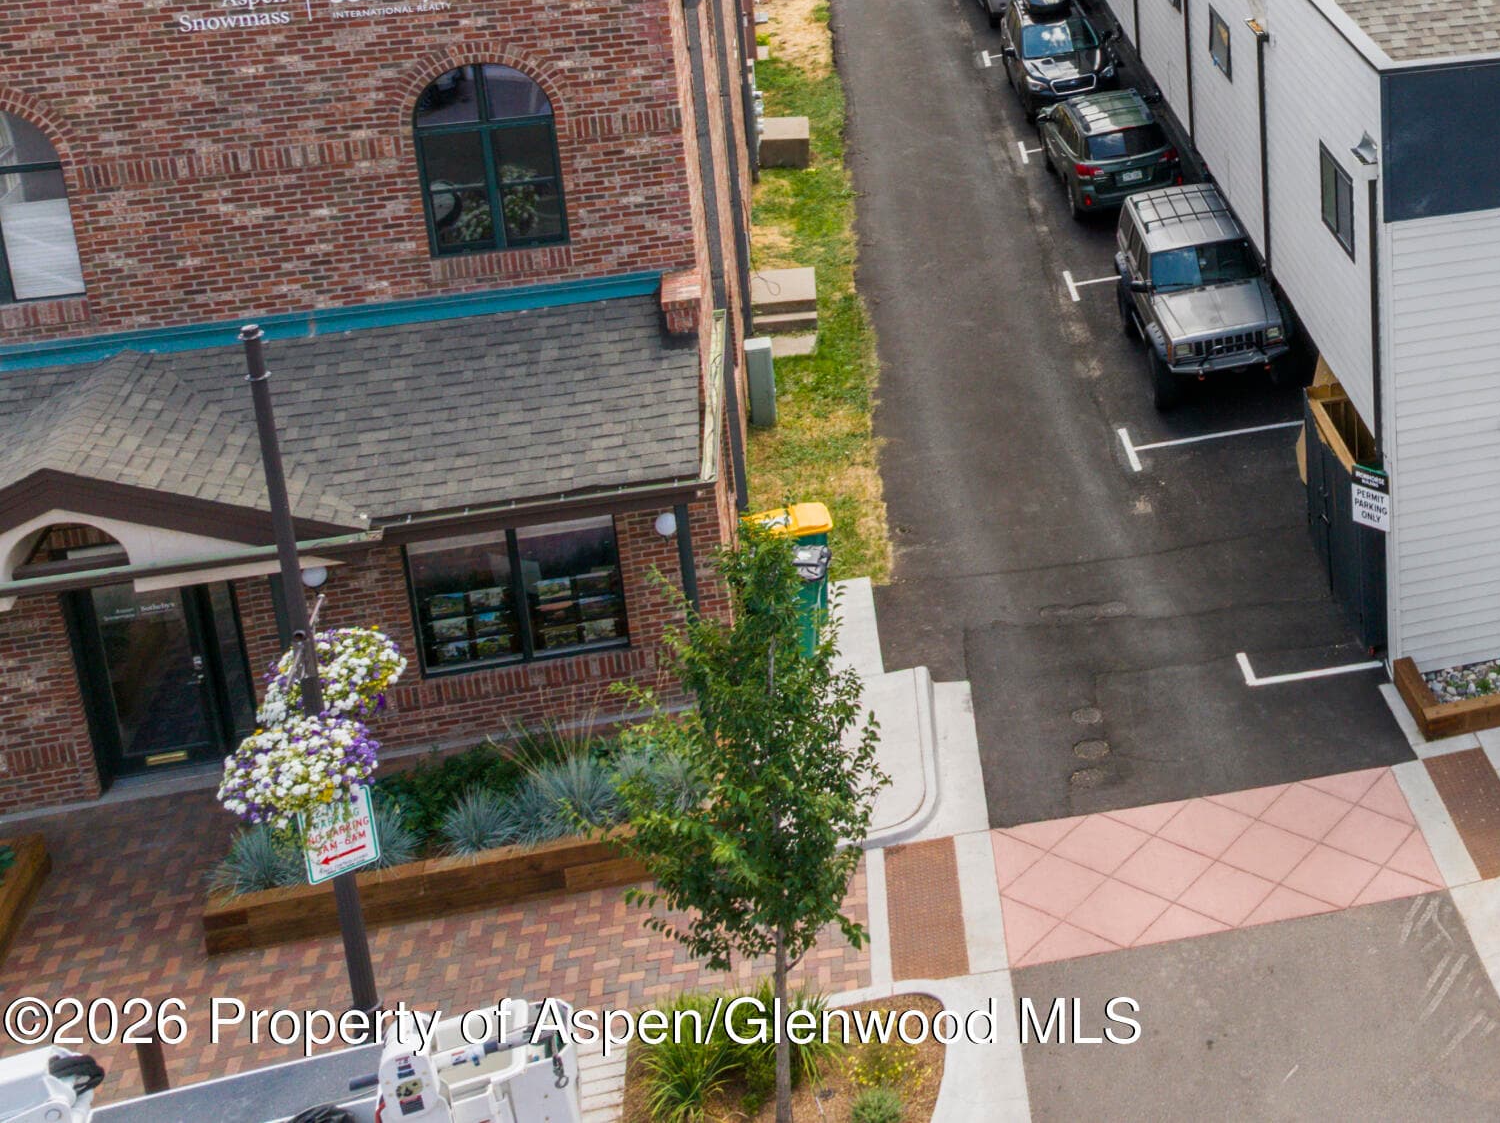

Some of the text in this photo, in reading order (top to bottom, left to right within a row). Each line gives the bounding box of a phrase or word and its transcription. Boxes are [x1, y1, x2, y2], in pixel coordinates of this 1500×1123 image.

[332, 2, 453, 19] INTERNATIONAL REALTY
[179, 11, 291, 33] Snowmass
[1356, 488, 1385, 504] PERMIT
[1354, 497, 1388, 516] PARKING
[1361, 510, 1382, 524] ONLY
